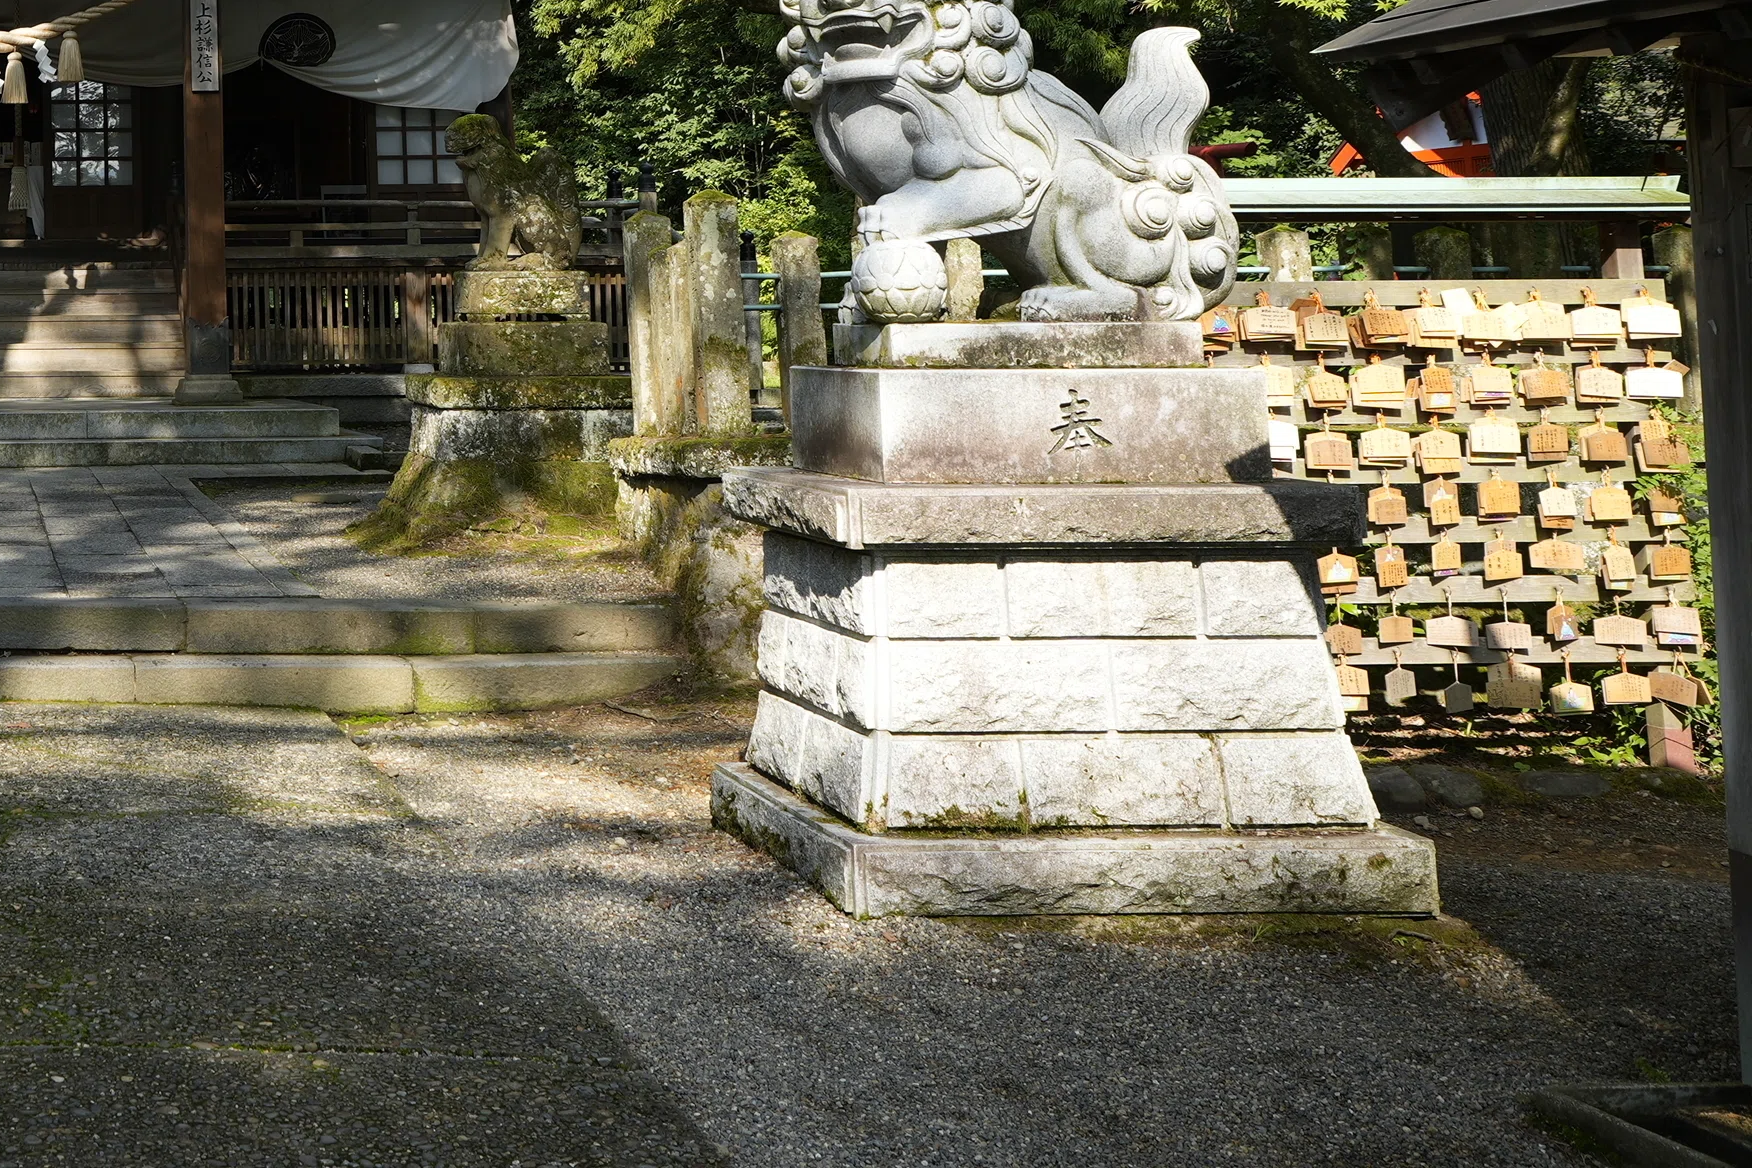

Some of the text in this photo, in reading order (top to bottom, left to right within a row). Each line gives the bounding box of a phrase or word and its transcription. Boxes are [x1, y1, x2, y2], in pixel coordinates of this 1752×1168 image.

[194, 2, 214, 83] 上杉謙信公
[1047, 388, 1113, 458] 奉
